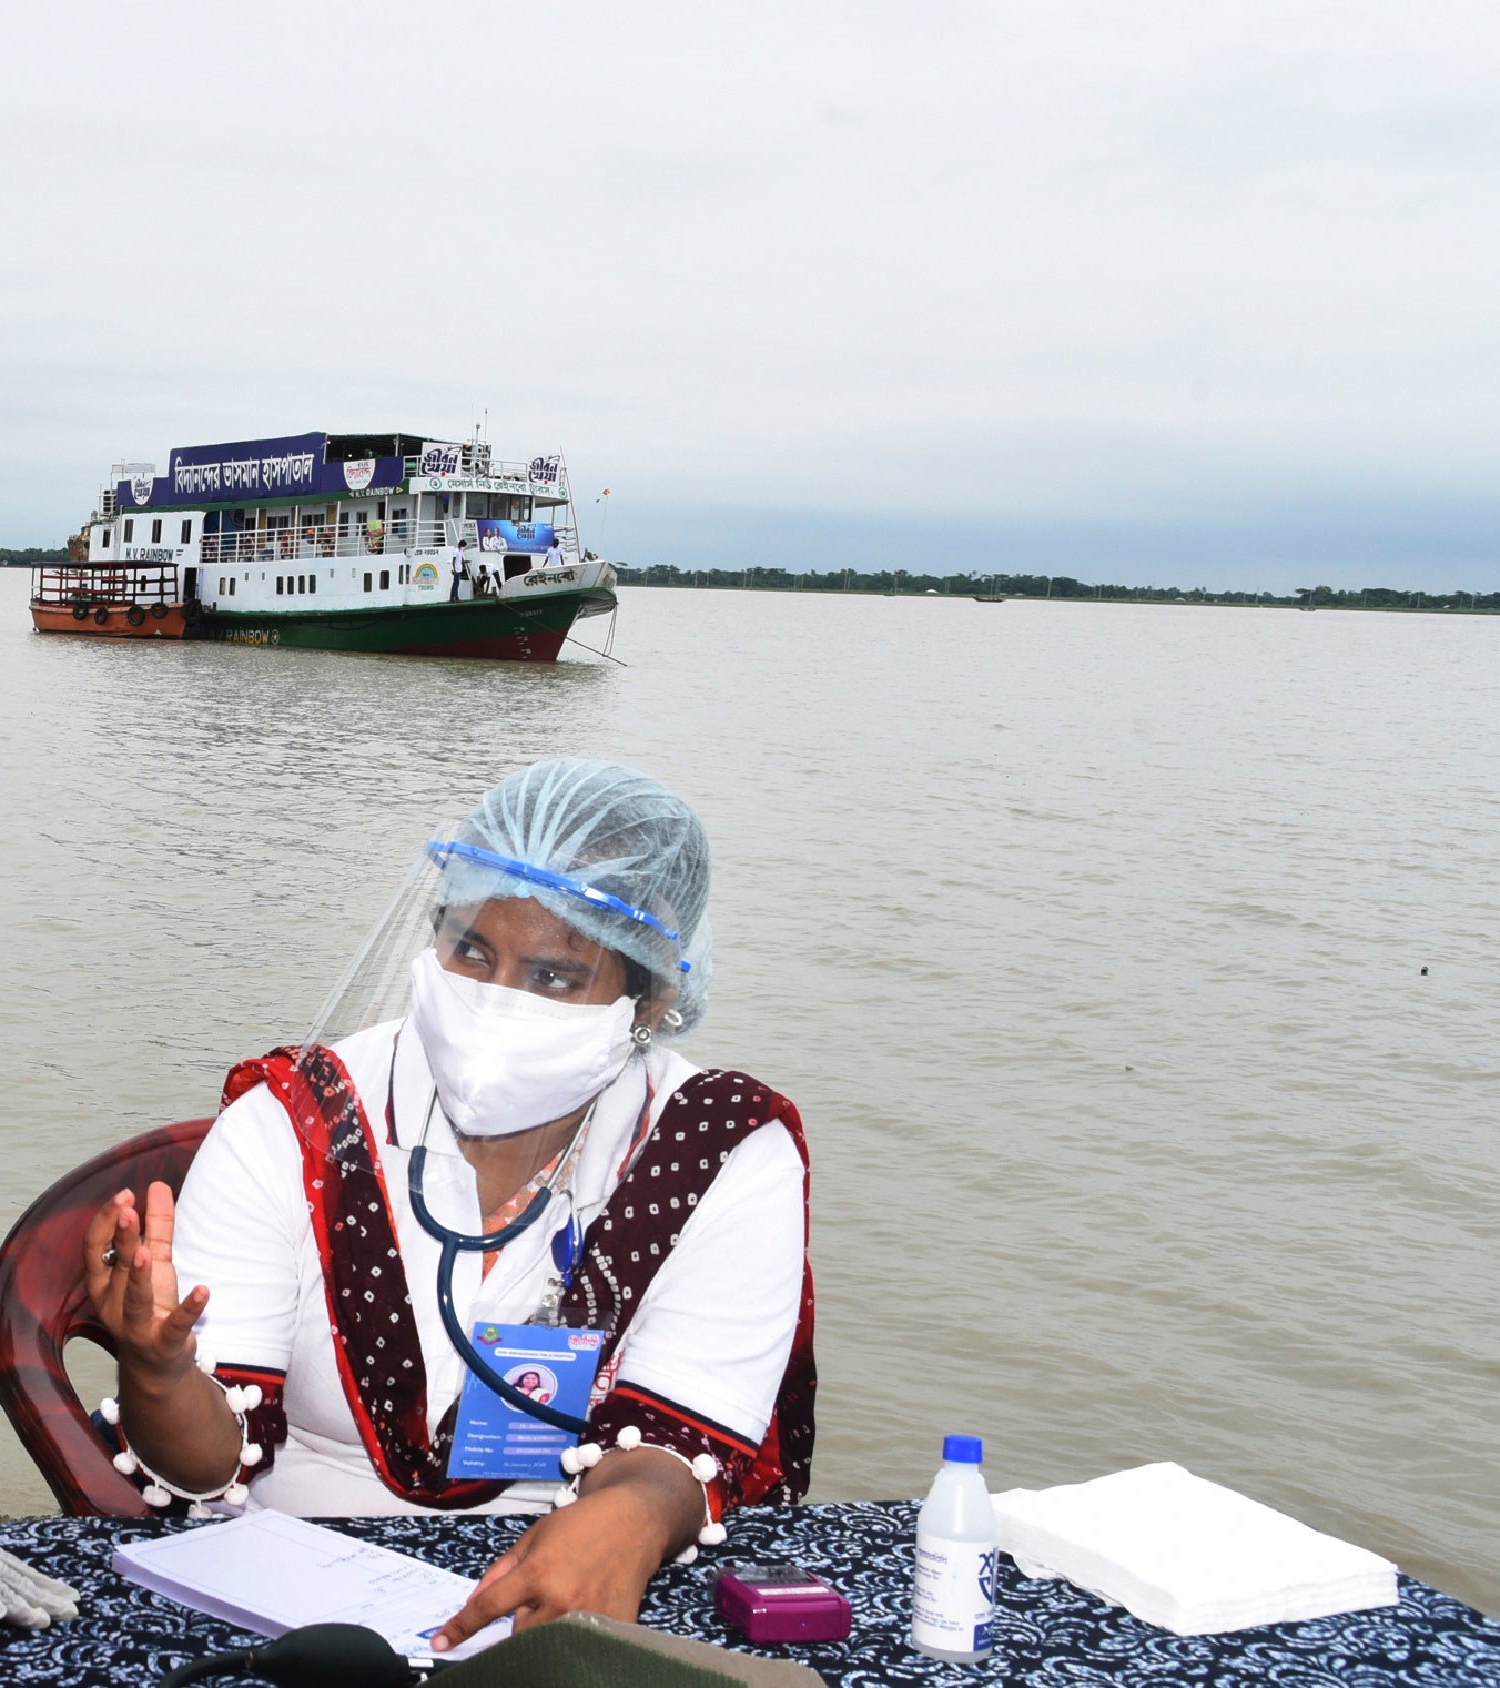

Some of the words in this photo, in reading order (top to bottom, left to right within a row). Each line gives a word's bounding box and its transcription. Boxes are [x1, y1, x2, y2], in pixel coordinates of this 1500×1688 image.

[174, 456, 221, 494] বিদ্যানন্দের
[222, 457, 261, 489] ভাসমান
[261, 451, 315, 491] হাসপাতাল
[140, 547, 174, 562] RAINBOW
[226, 629, 269, 645] RAINBOW
